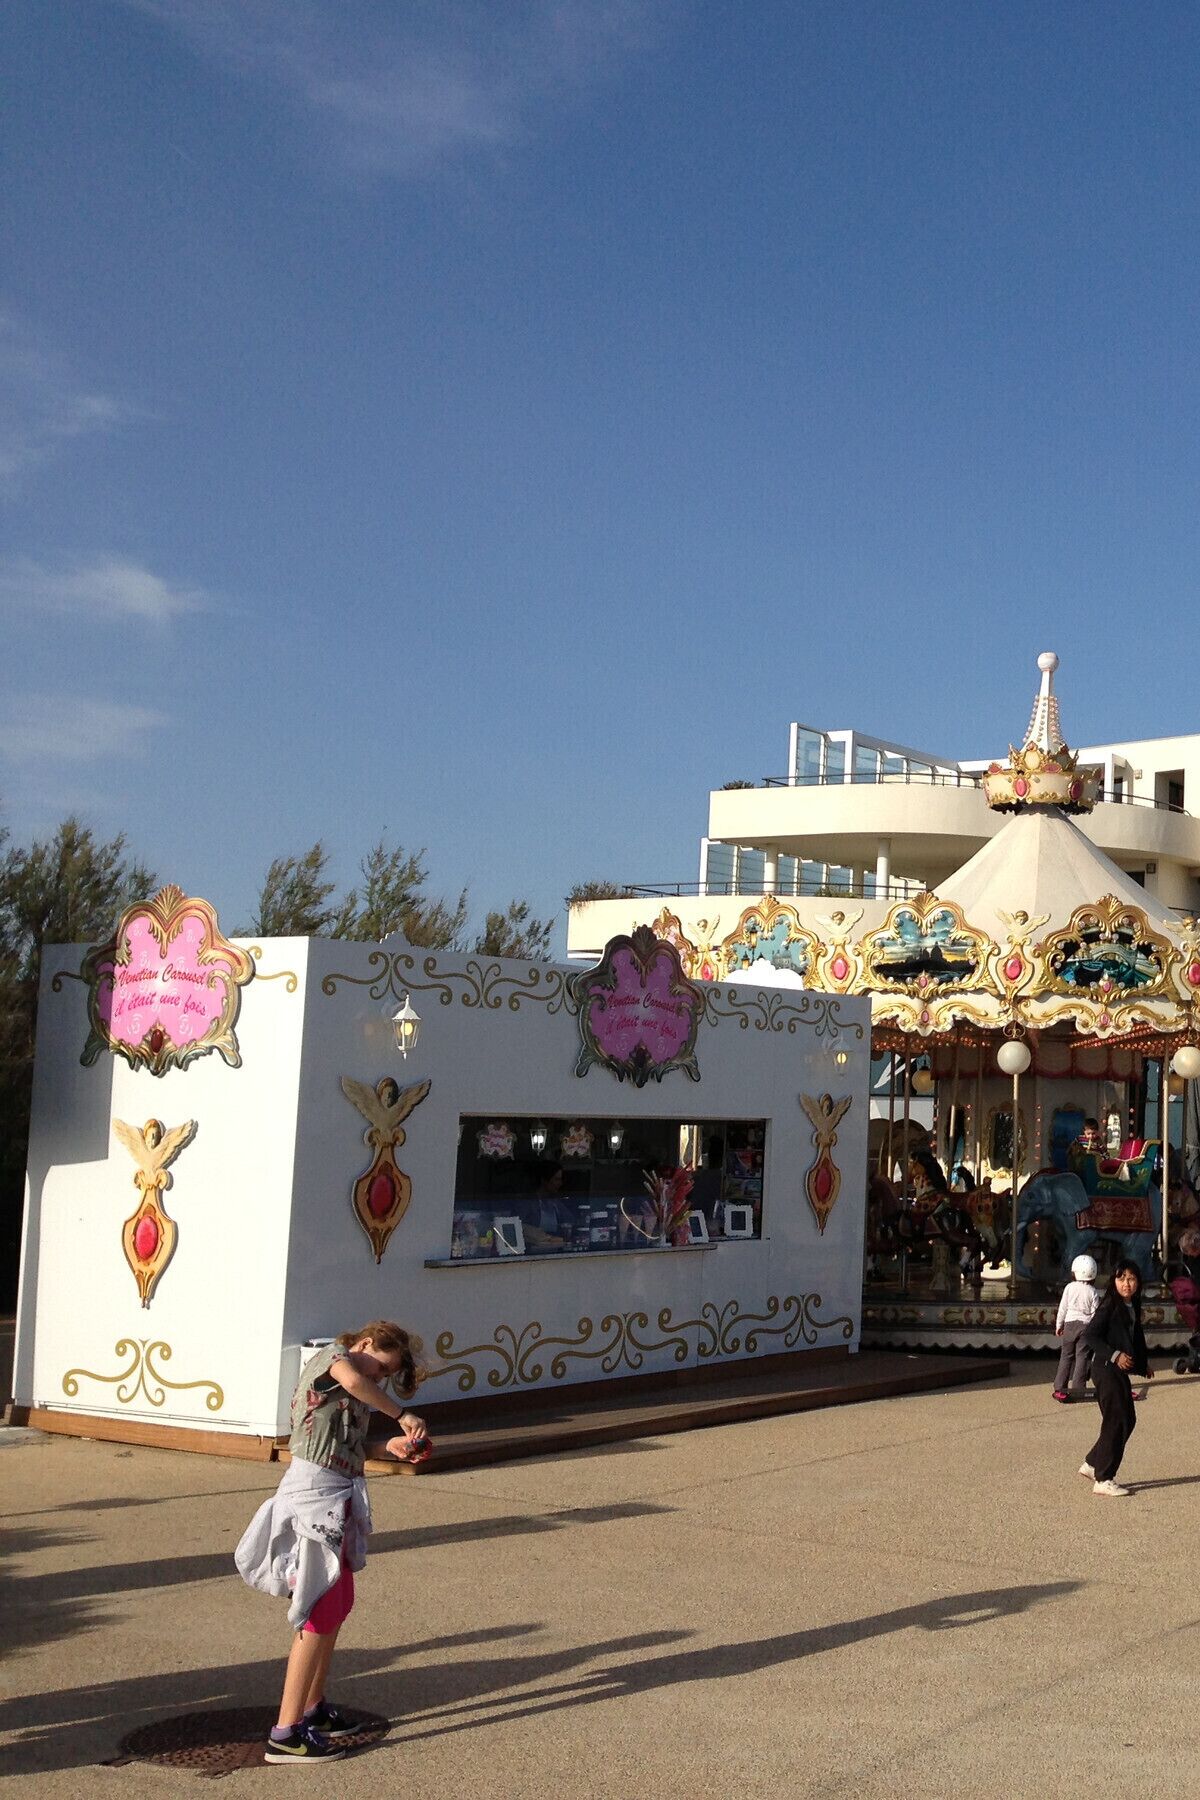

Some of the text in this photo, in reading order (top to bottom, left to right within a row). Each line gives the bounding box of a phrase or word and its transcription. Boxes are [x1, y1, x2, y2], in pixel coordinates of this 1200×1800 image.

[118, 963, 207, 987] Venetian Carousel
[114, 998, 126, 1017] il
[160, 994, 181, 1006] une
[183, 993, 206, 1016] fois
